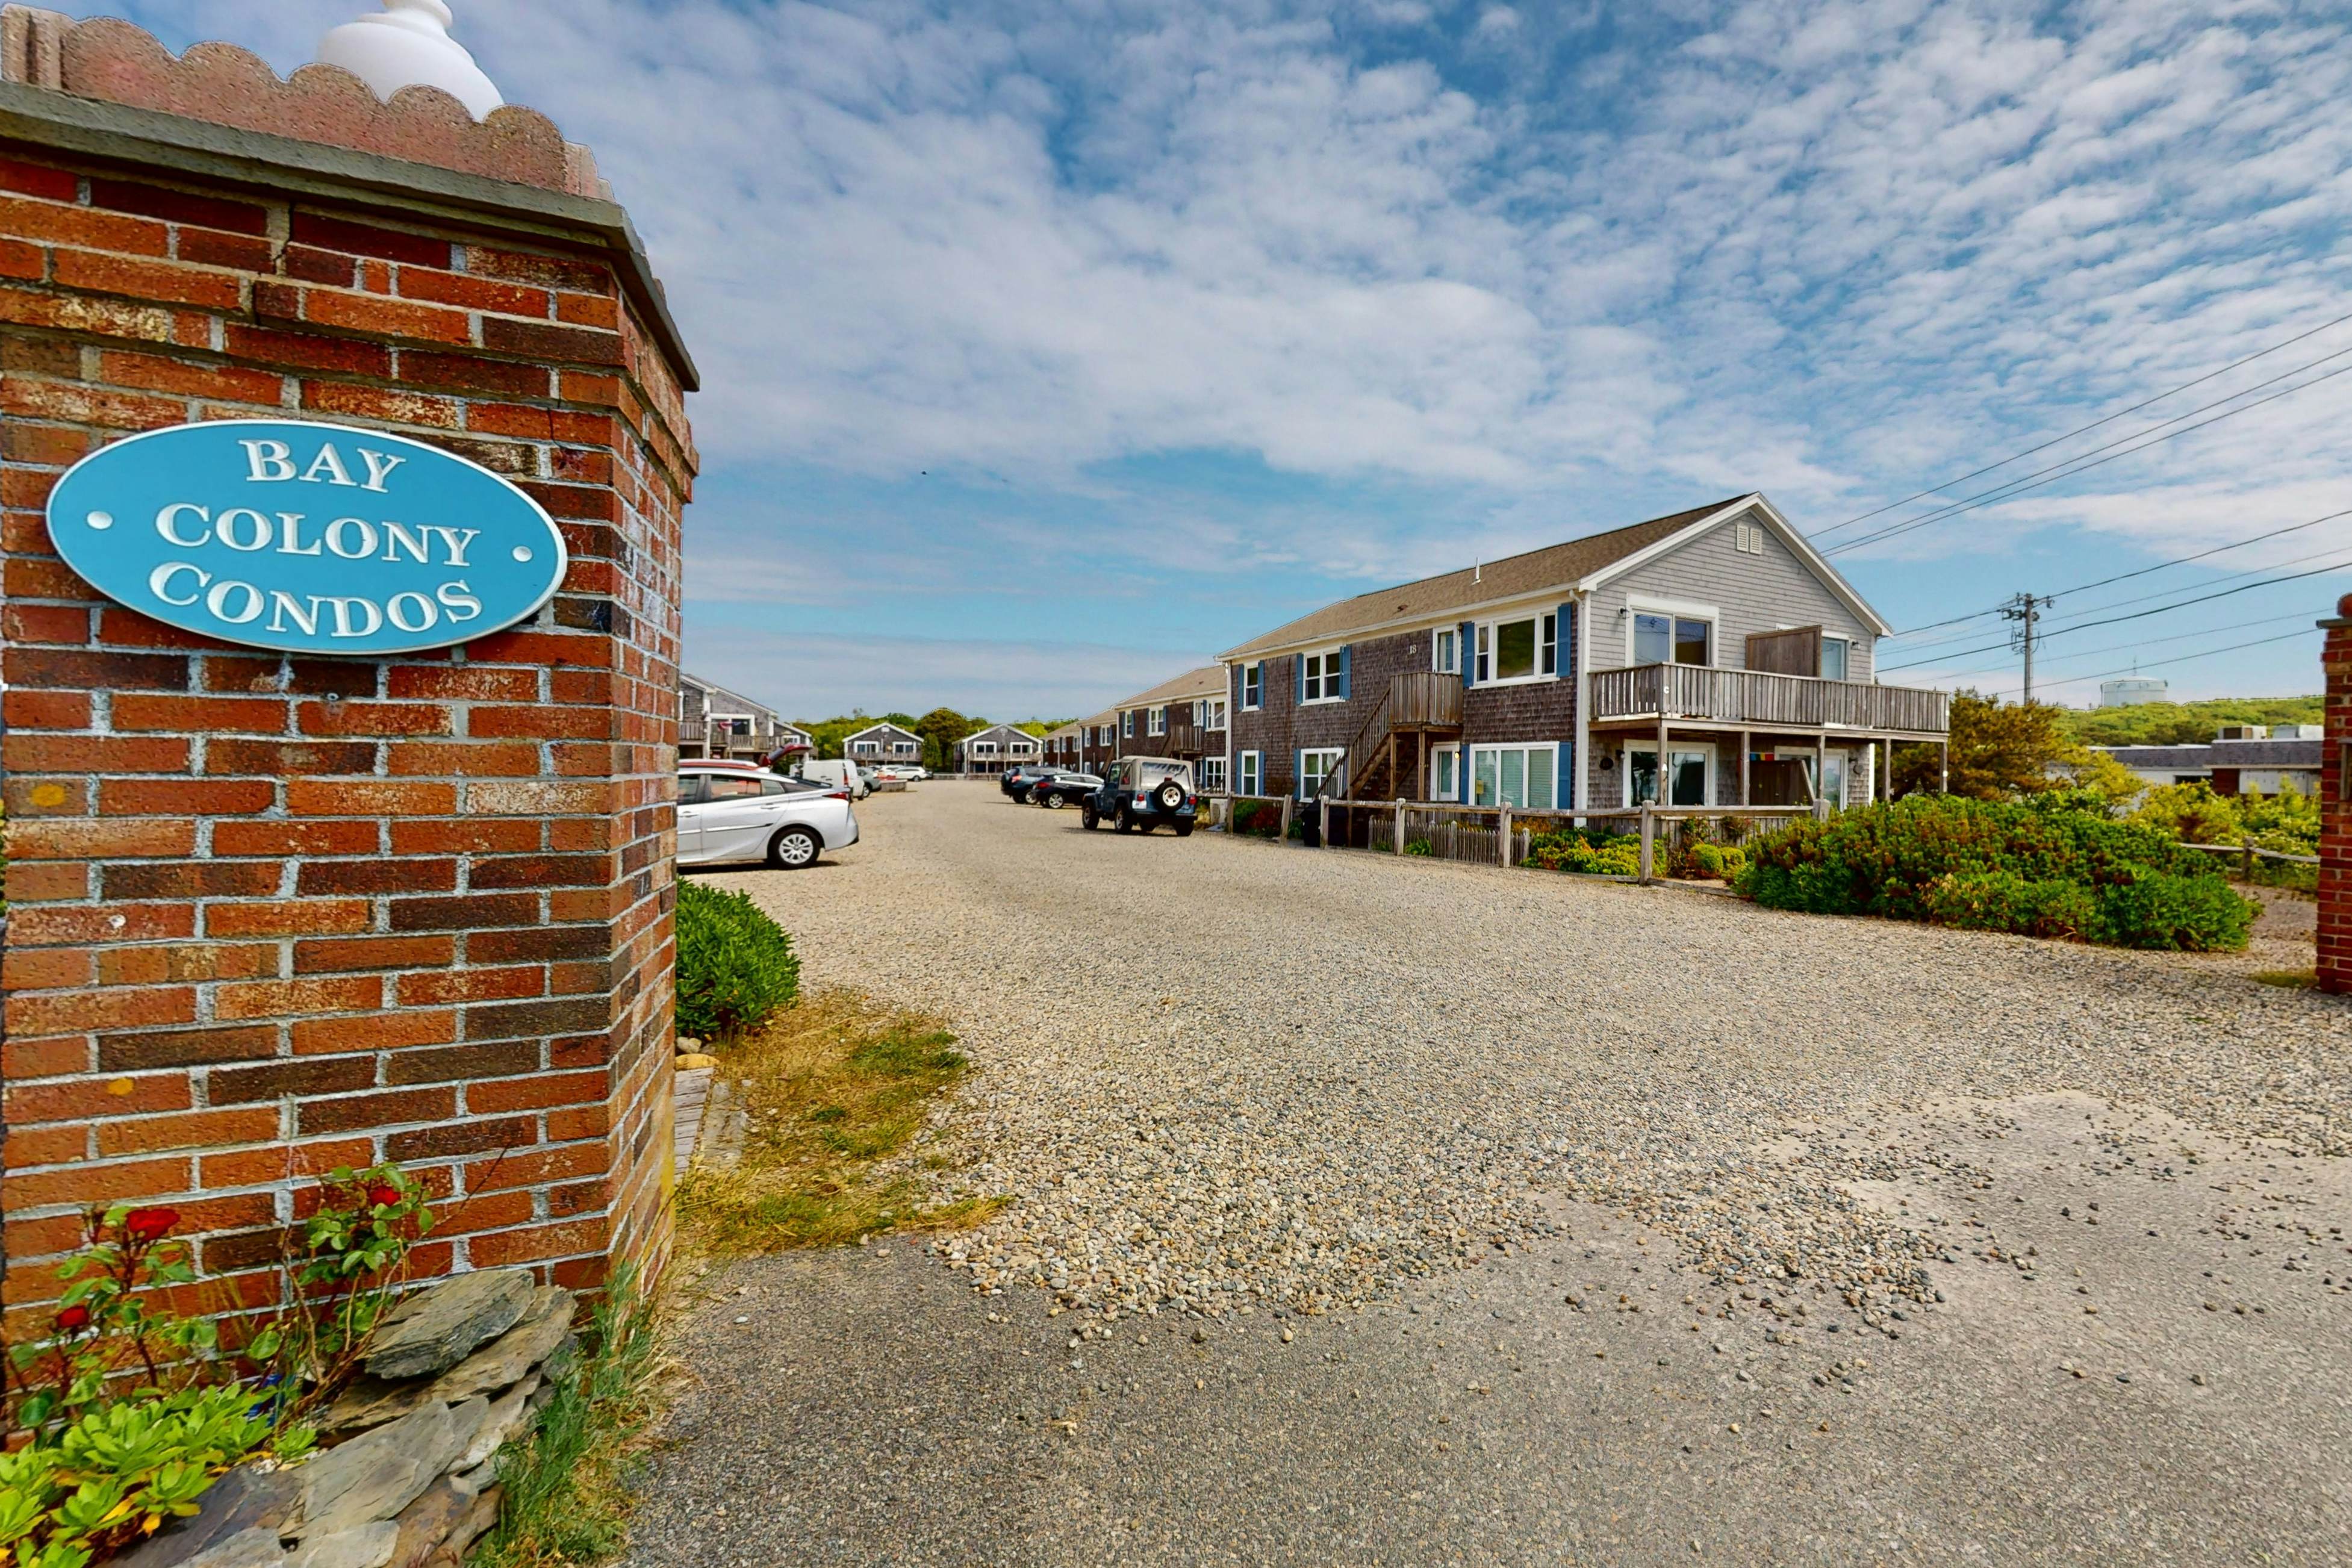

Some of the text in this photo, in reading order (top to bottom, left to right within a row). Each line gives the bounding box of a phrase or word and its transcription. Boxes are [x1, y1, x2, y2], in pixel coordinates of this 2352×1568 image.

[239, 440, 406, 493] BAY
[155, 503, 481, 567] COLONY
[149, 562, 482, 637] CONDOS
[1410, 644, 1417, 655] 18
